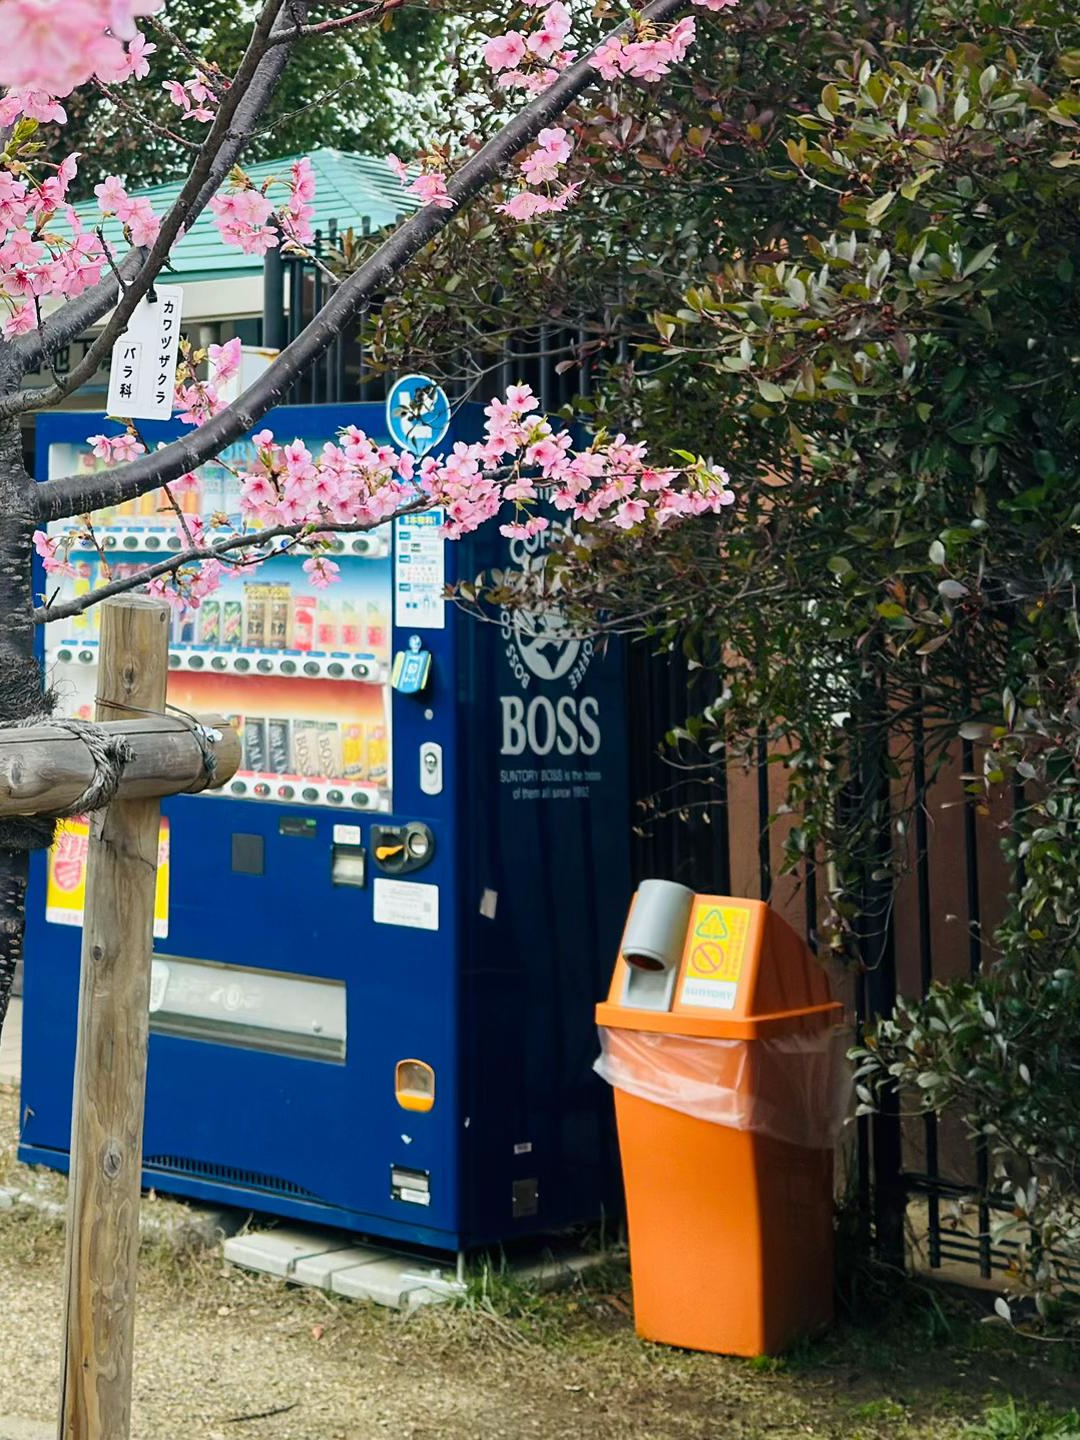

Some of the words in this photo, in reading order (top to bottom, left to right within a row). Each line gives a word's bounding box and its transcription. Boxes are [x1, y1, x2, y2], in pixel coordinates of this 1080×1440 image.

[120, 347, 136, 398] バラ科
[500, 695, 601, 755] BOSS
